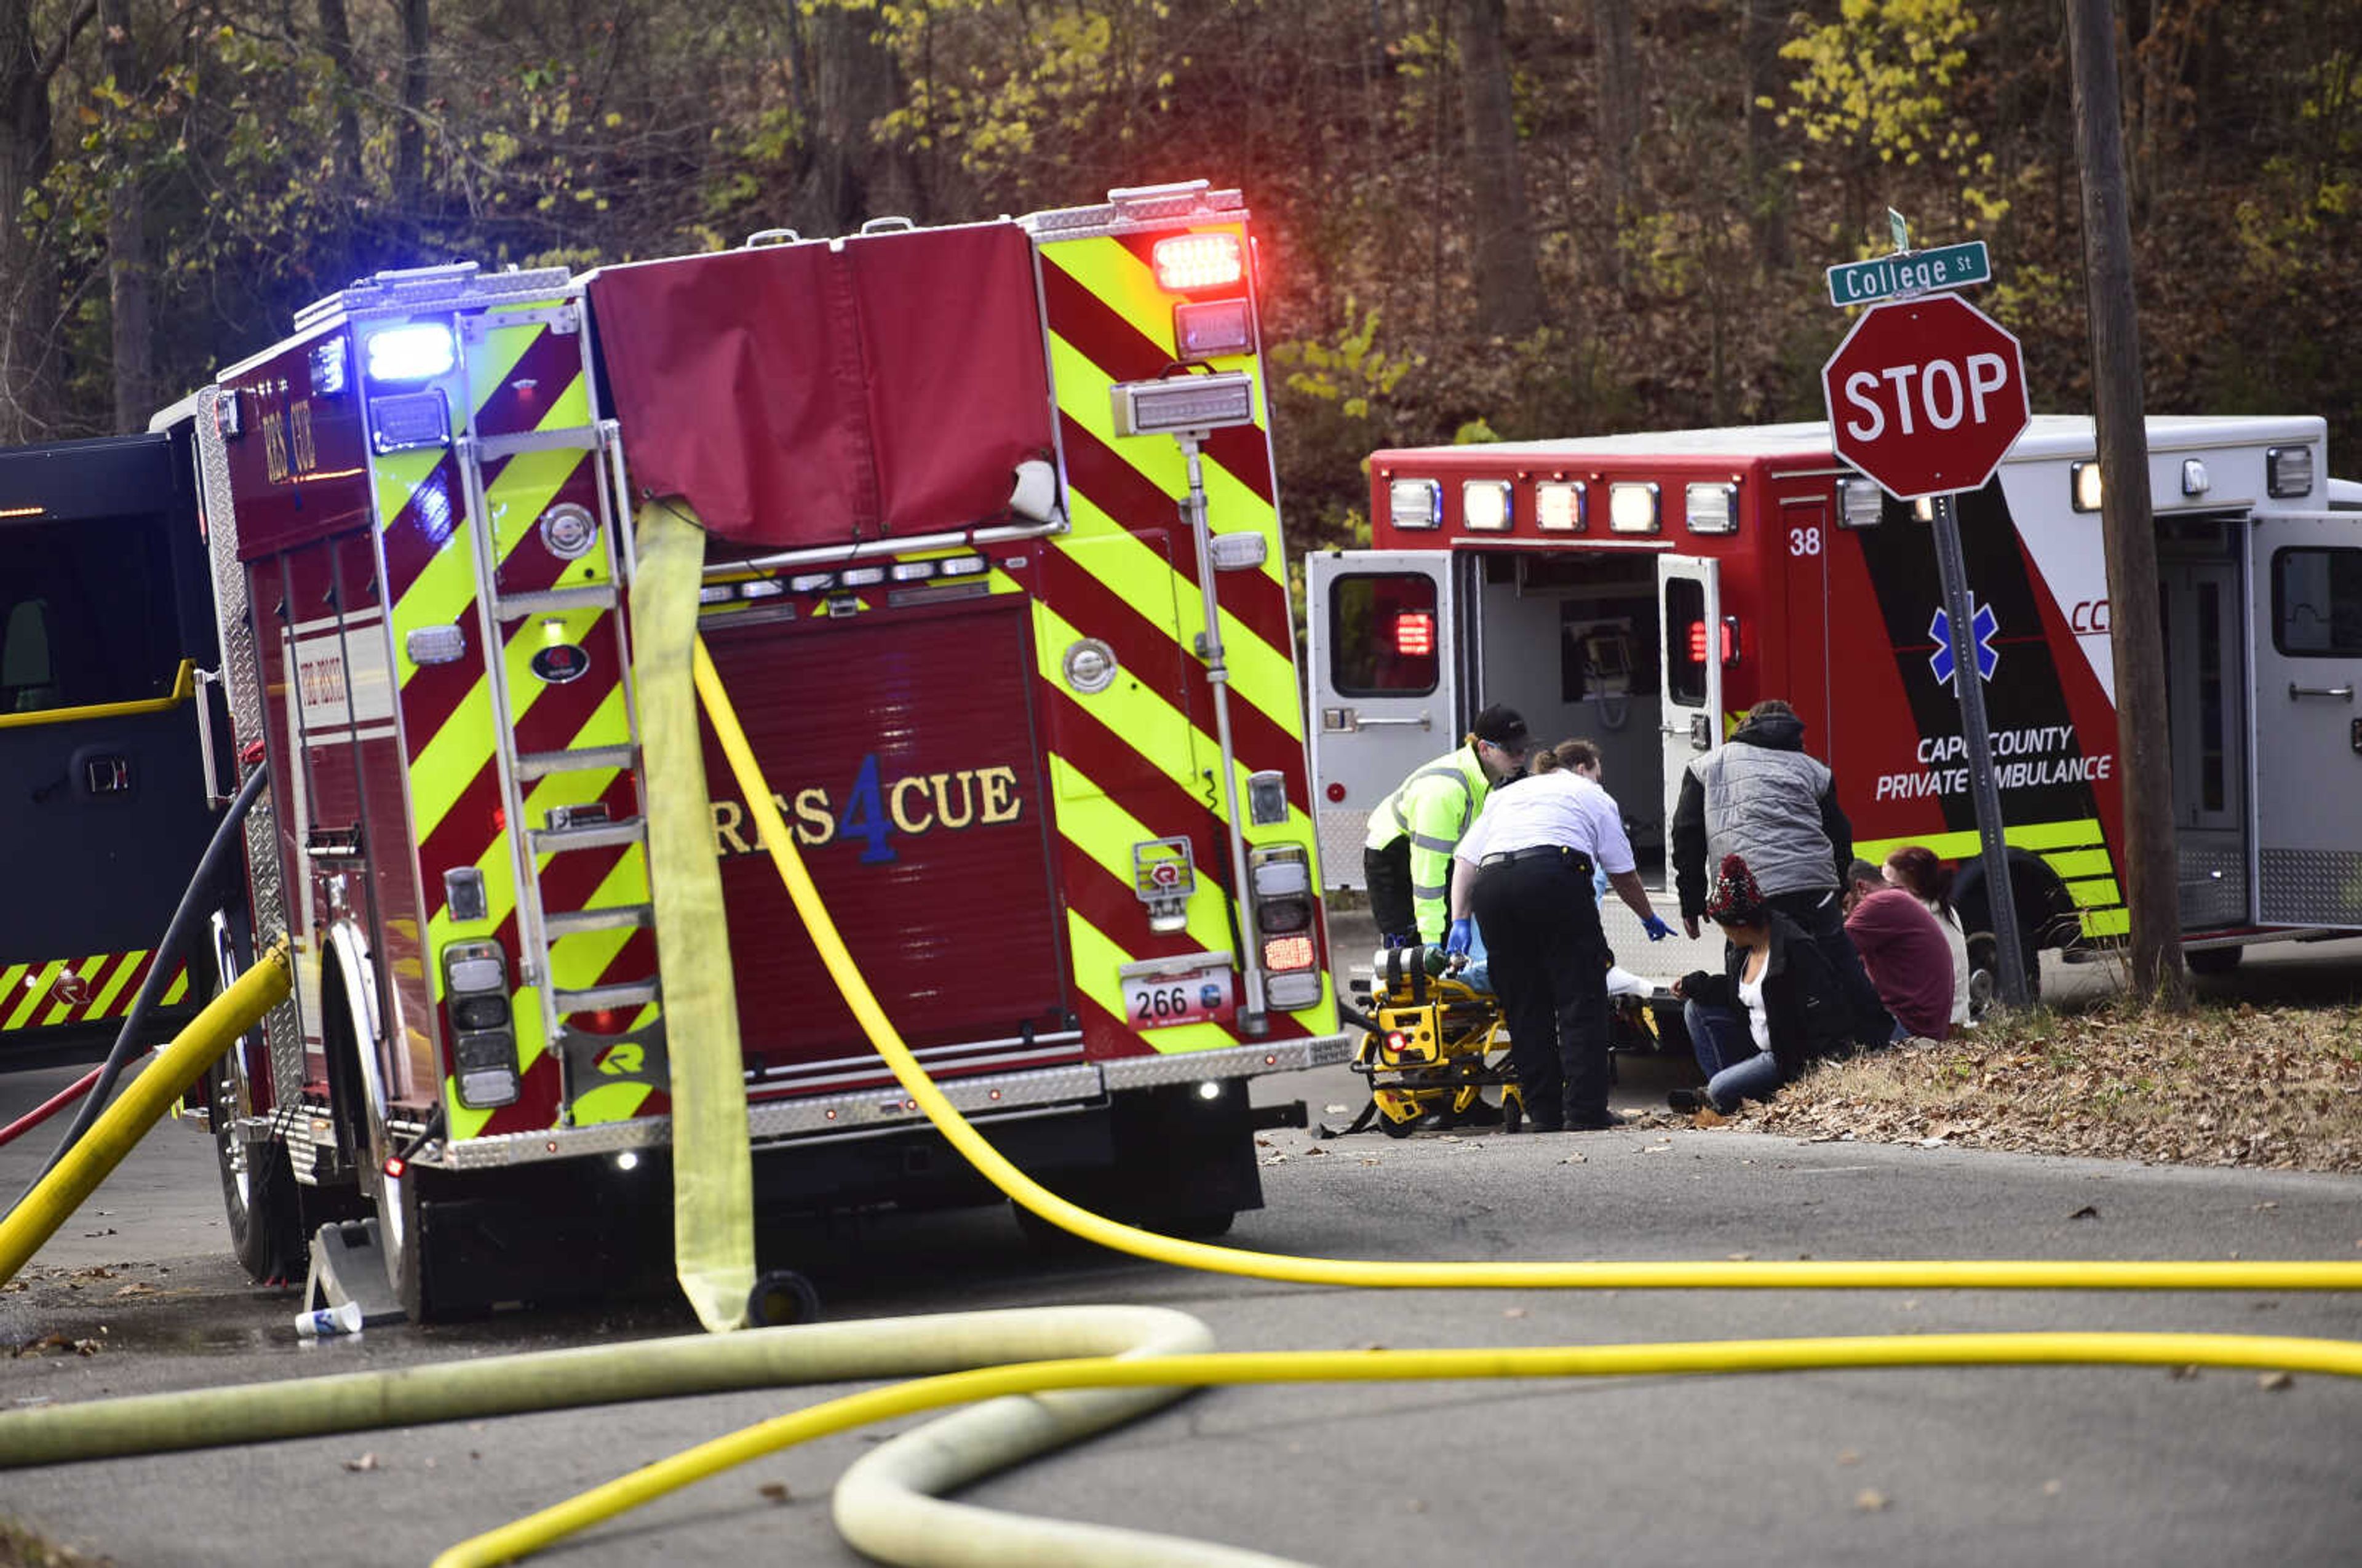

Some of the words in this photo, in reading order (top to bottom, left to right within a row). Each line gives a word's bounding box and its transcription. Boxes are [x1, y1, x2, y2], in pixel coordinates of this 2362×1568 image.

[1847, 260, 1946, 298] College
[1957, 255, 1972, 273] St
[1845, 353, 2008, 442] STOP
[1790, 528, 1820, 555] 38
[2072, 600, 2112, 631] CC
[1989, 725, 2074, 757] COUNTY
[1877, 770, 1968, 801] PRIVATE
[1994, 755, 2112, 789] MBULANCE
[1136, 987, 1187, 1019] 266
